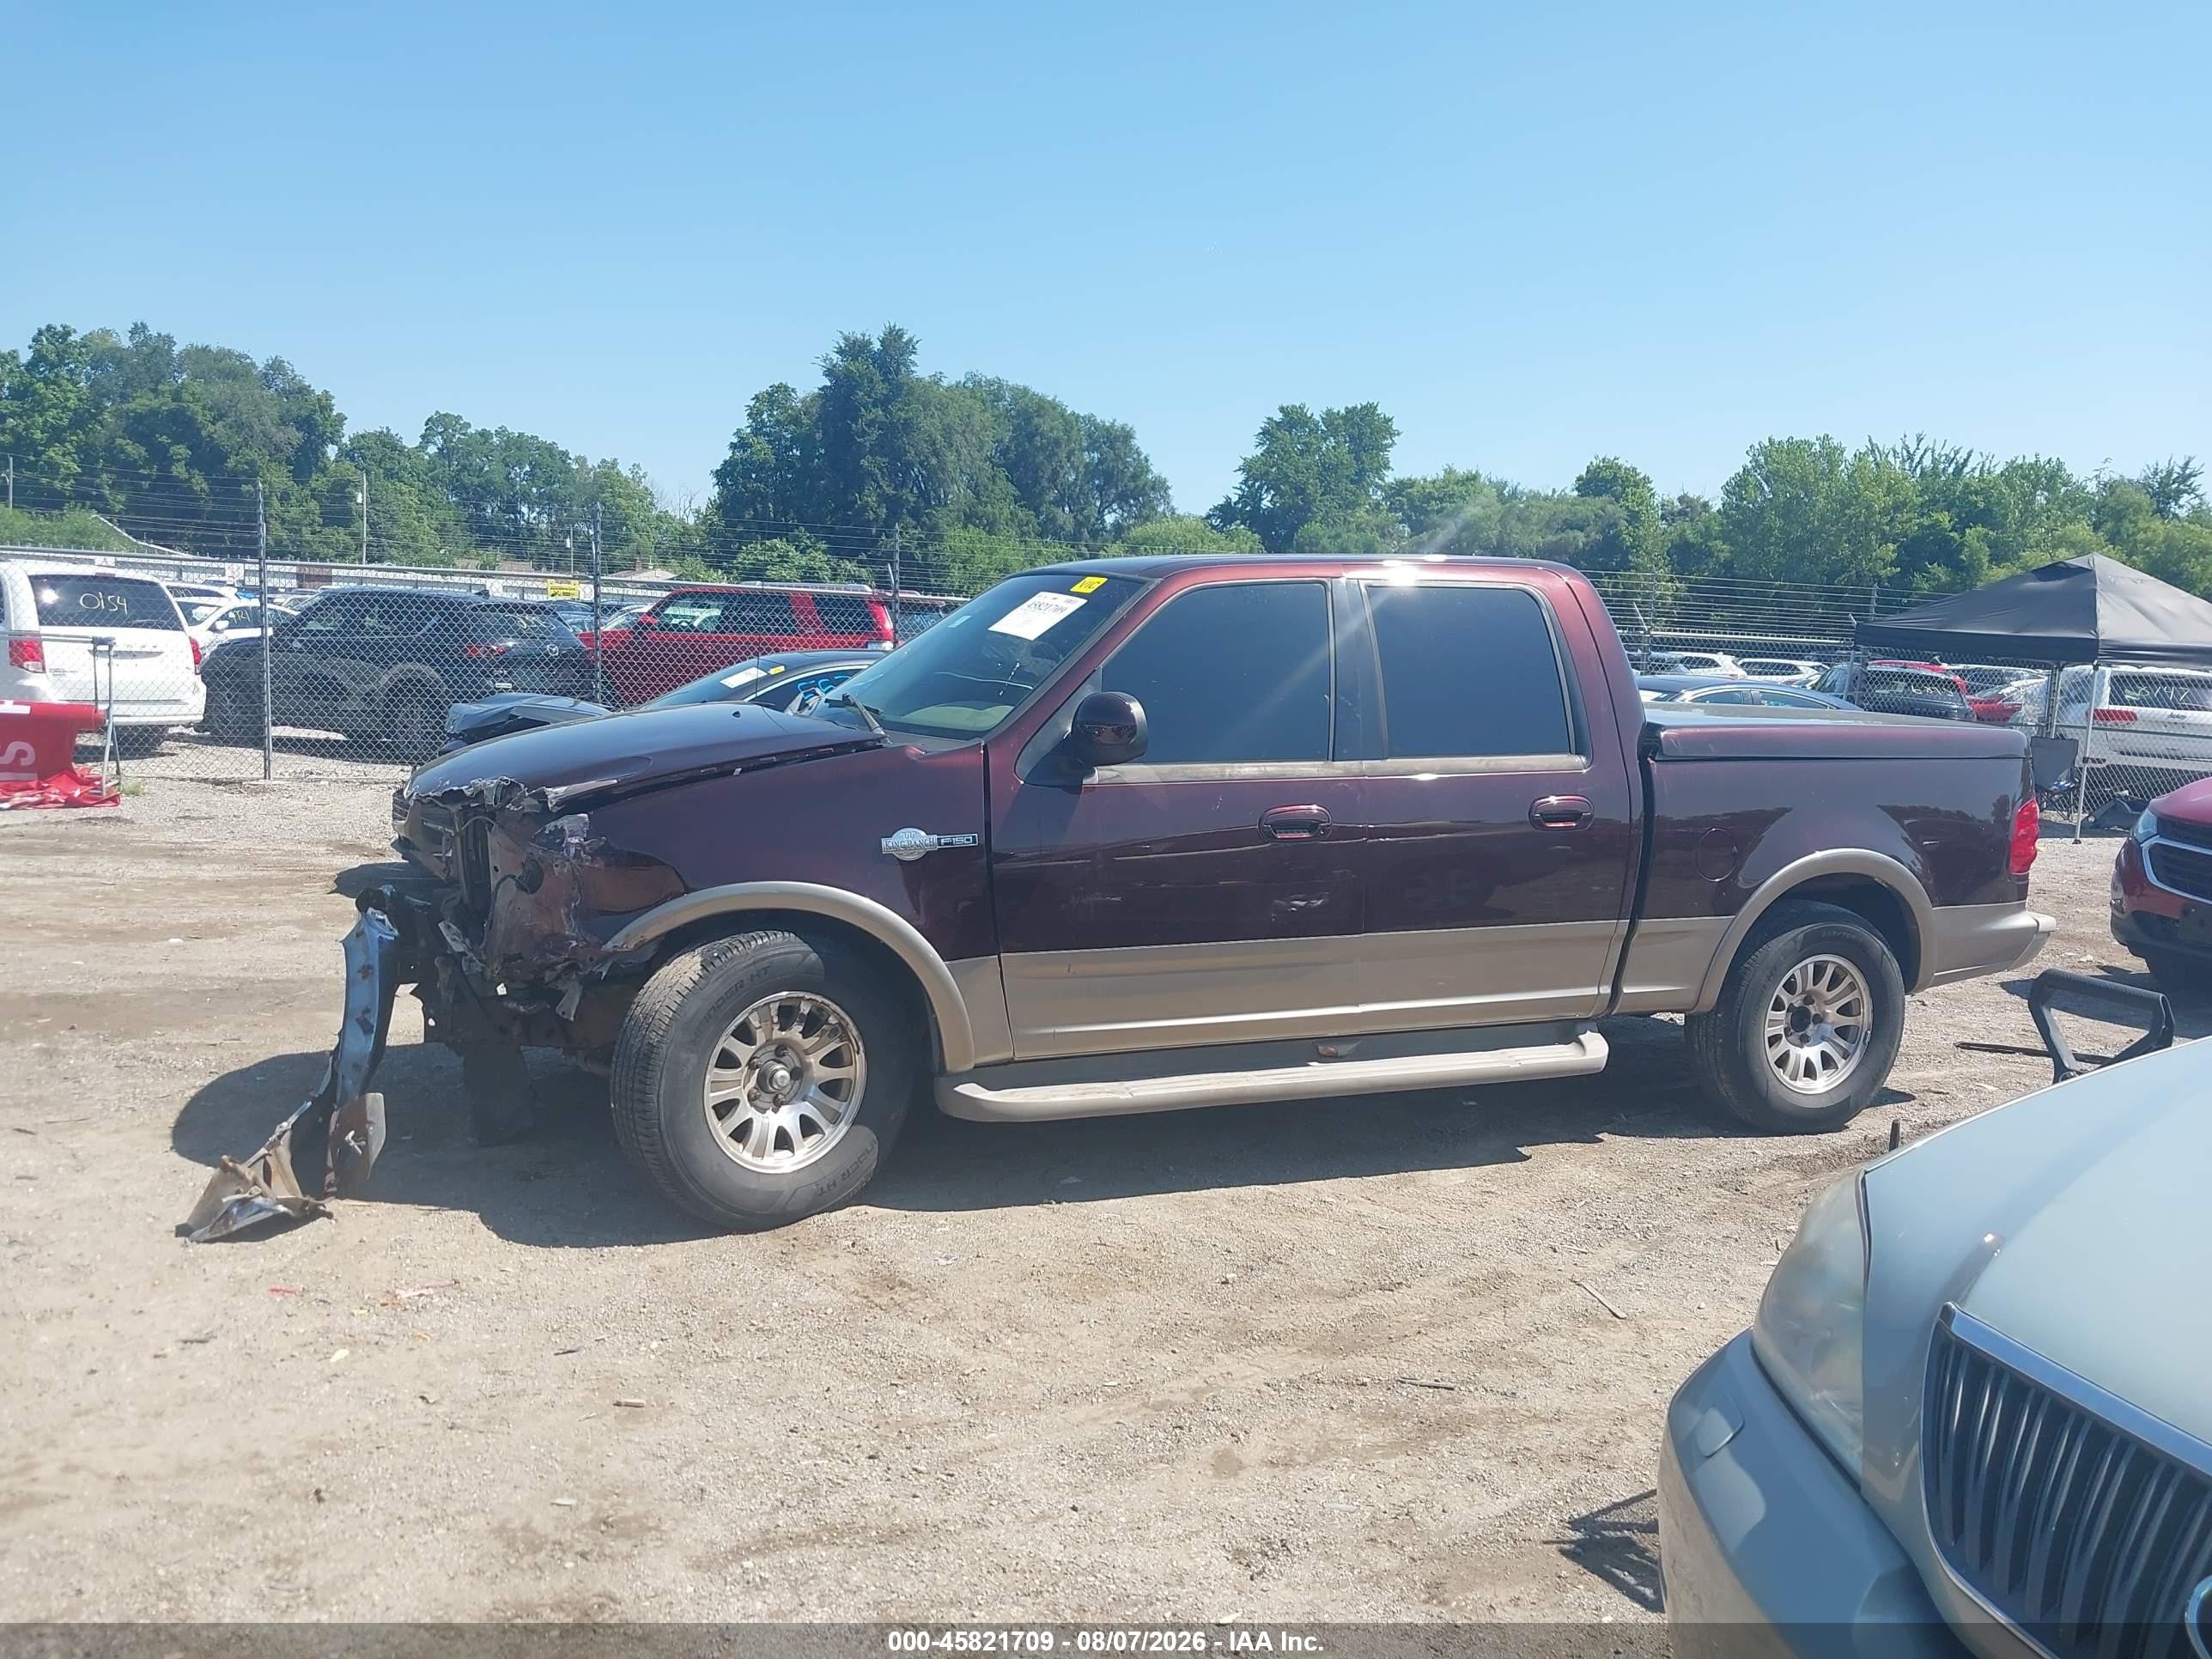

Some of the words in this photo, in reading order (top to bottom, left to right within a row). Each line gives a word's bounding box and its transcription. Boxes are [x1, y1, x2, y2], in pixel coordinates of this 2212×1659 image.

[79, 592, 128, 615] 0154
[884, 840, 906, 851] KING
[907, 837, 934, 850] RANCH
